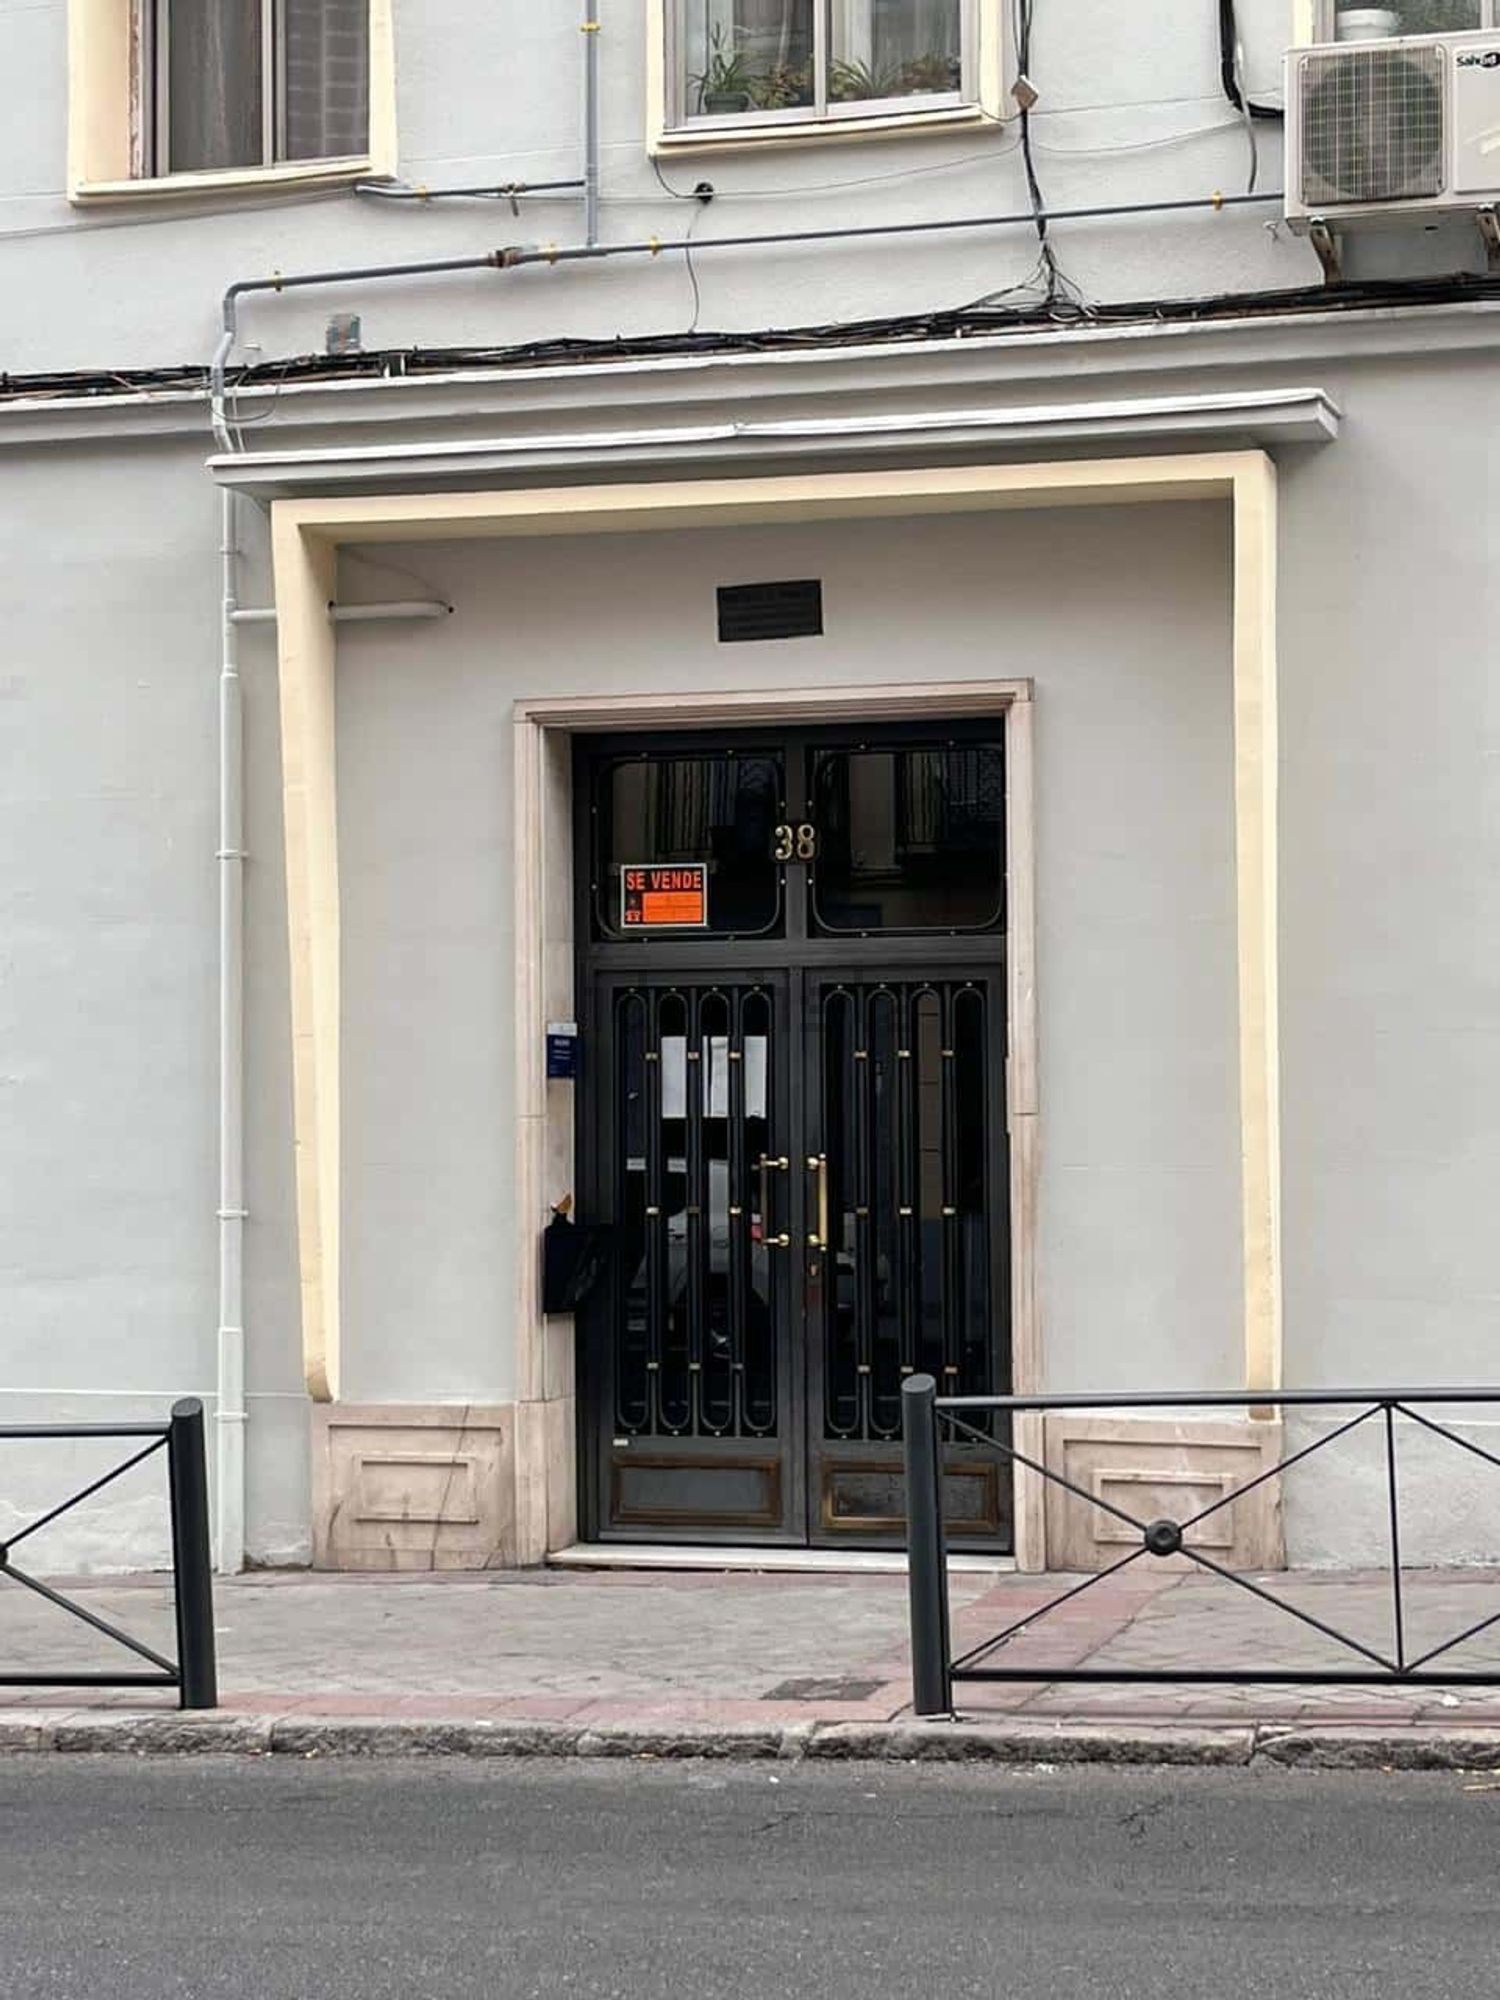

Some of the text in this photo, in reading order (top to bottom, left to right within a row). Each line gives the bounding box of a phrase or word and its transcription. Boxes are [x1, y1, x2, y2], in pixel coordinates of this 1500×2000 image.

[774, 824, 815, 860] 38
[626, 870, 702, 890] SE VENDE
